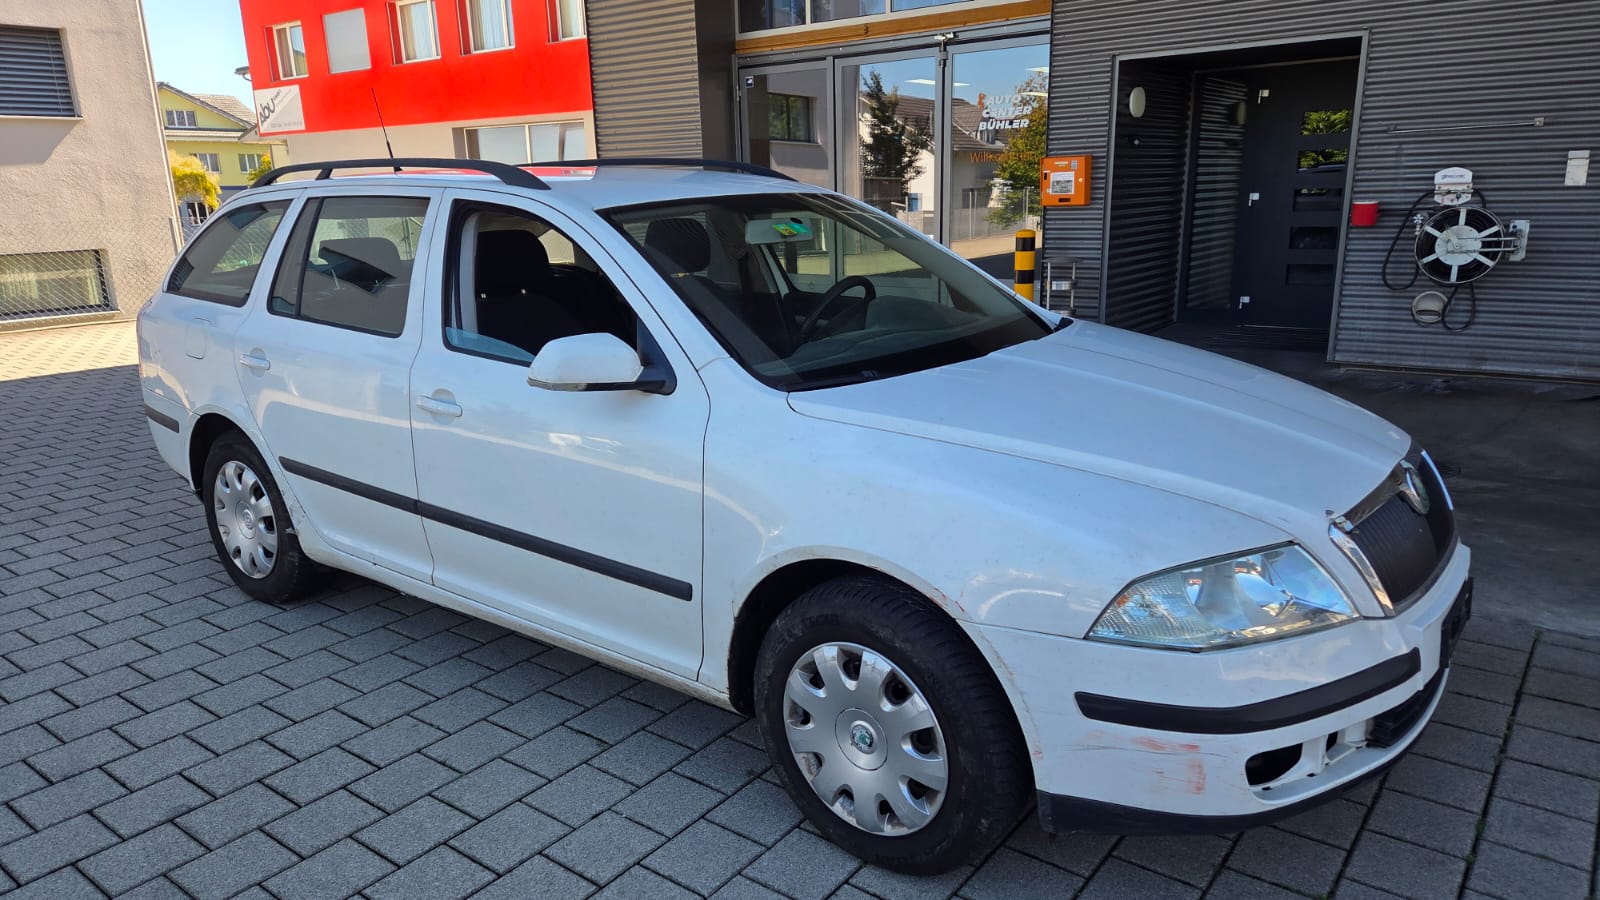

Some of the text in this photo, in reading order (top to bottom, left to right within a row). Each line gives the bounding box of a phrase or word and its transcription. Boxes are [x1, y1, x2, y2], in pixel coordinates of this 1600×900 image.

[986, 95, 1021, 105] AUTO
[982, 105, 1033, 118] CENTER
[979, 118, 1030, 130] BÜHLER
